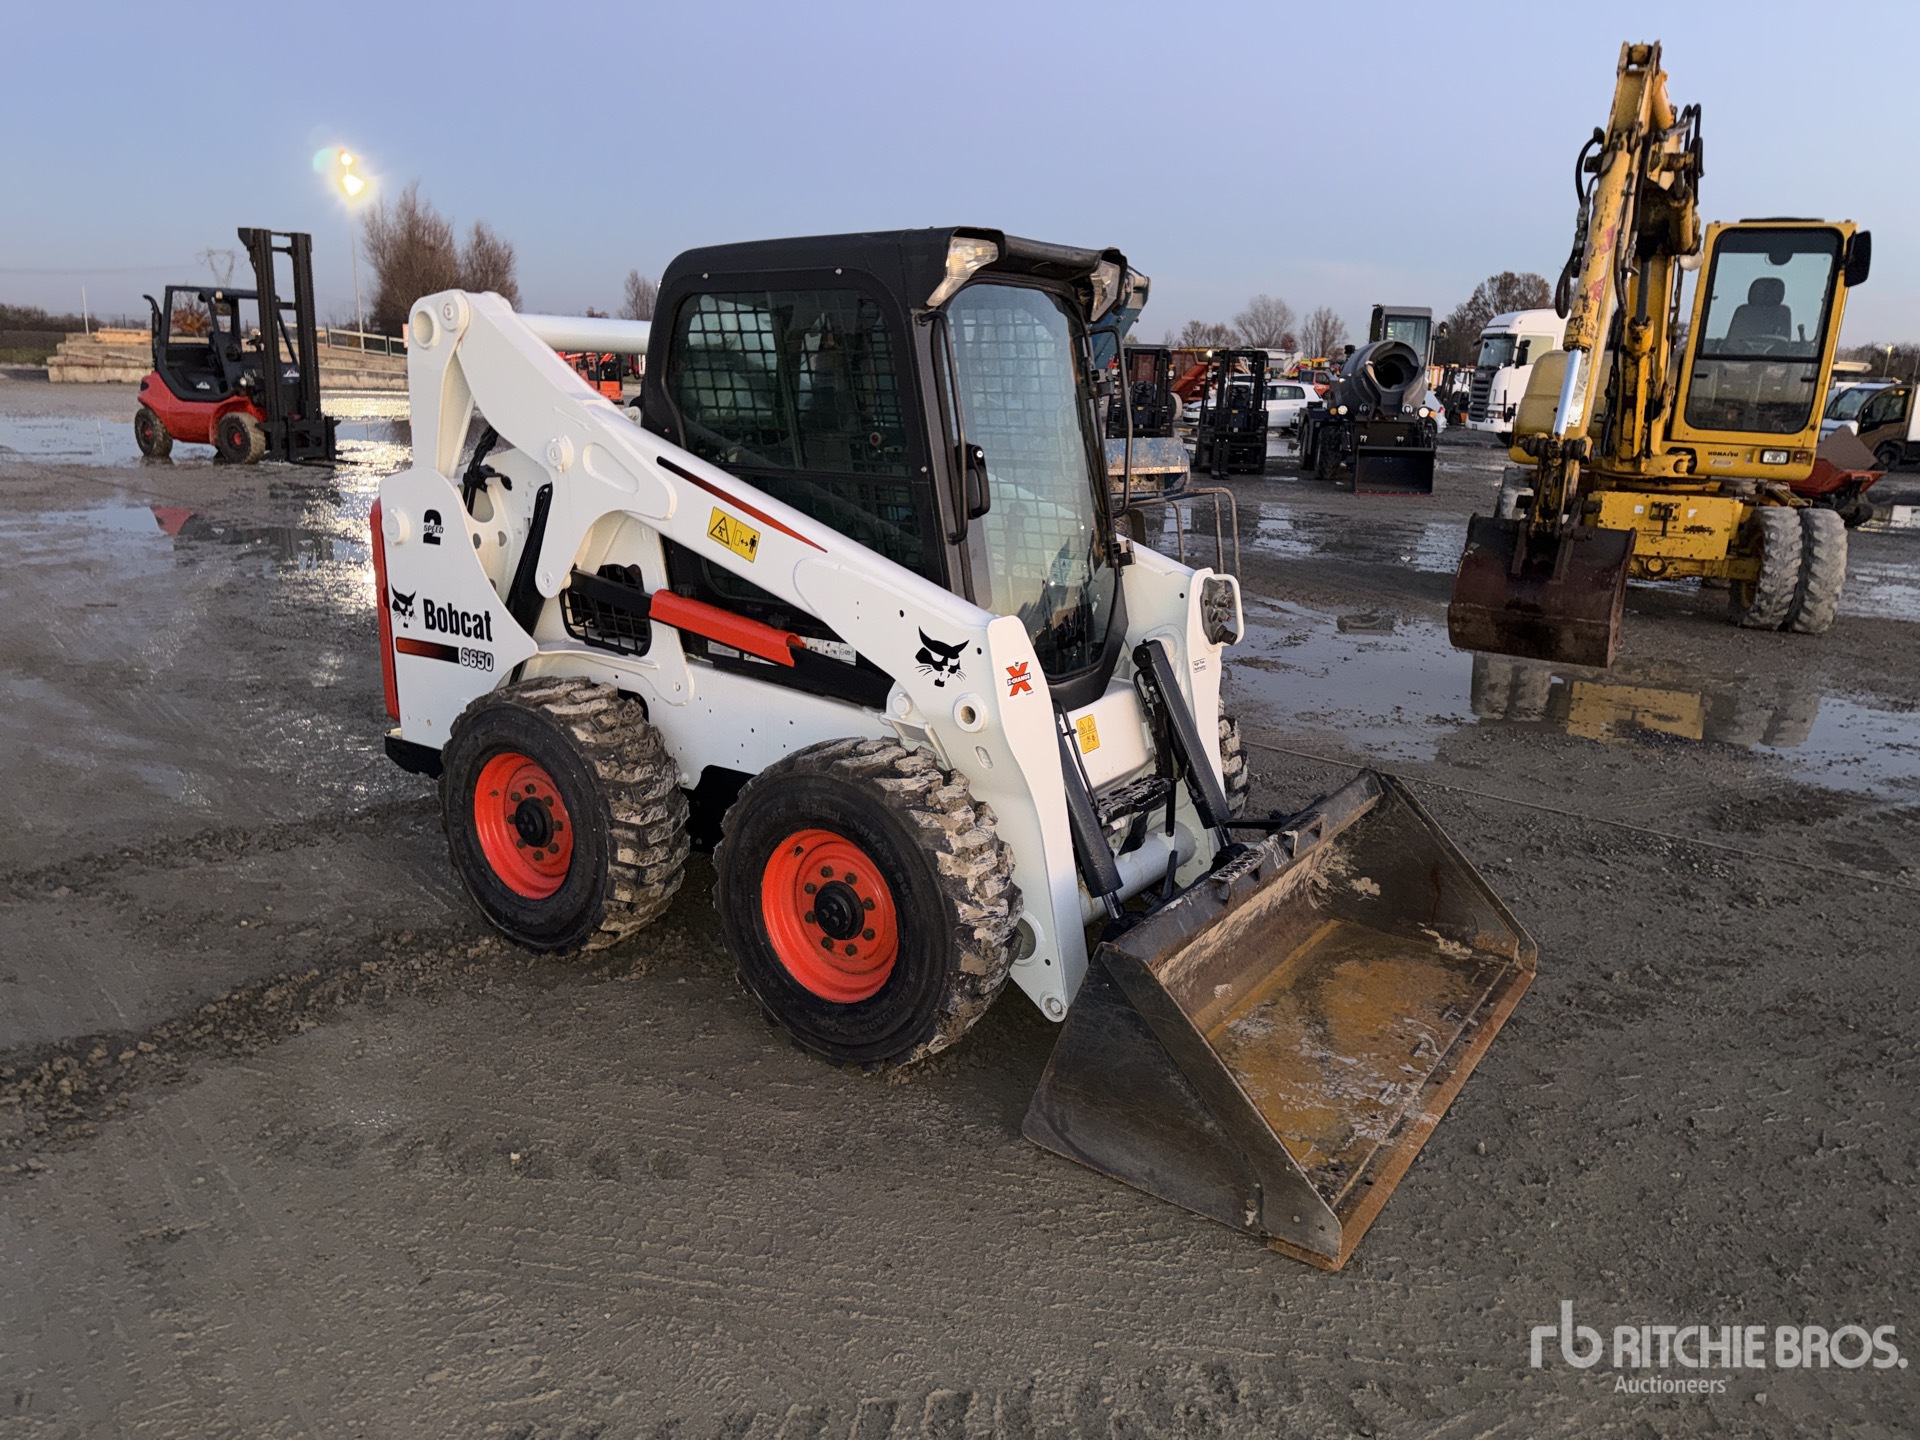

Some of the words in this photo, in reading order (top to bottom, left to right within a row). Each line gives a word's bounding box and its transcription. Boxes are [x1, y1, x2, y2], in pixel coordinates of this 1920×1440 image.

[424, 524, 444, 534] SPEED
[423, 598, 493, 642] Bobcat
[460, 647, 494, 672] S650
